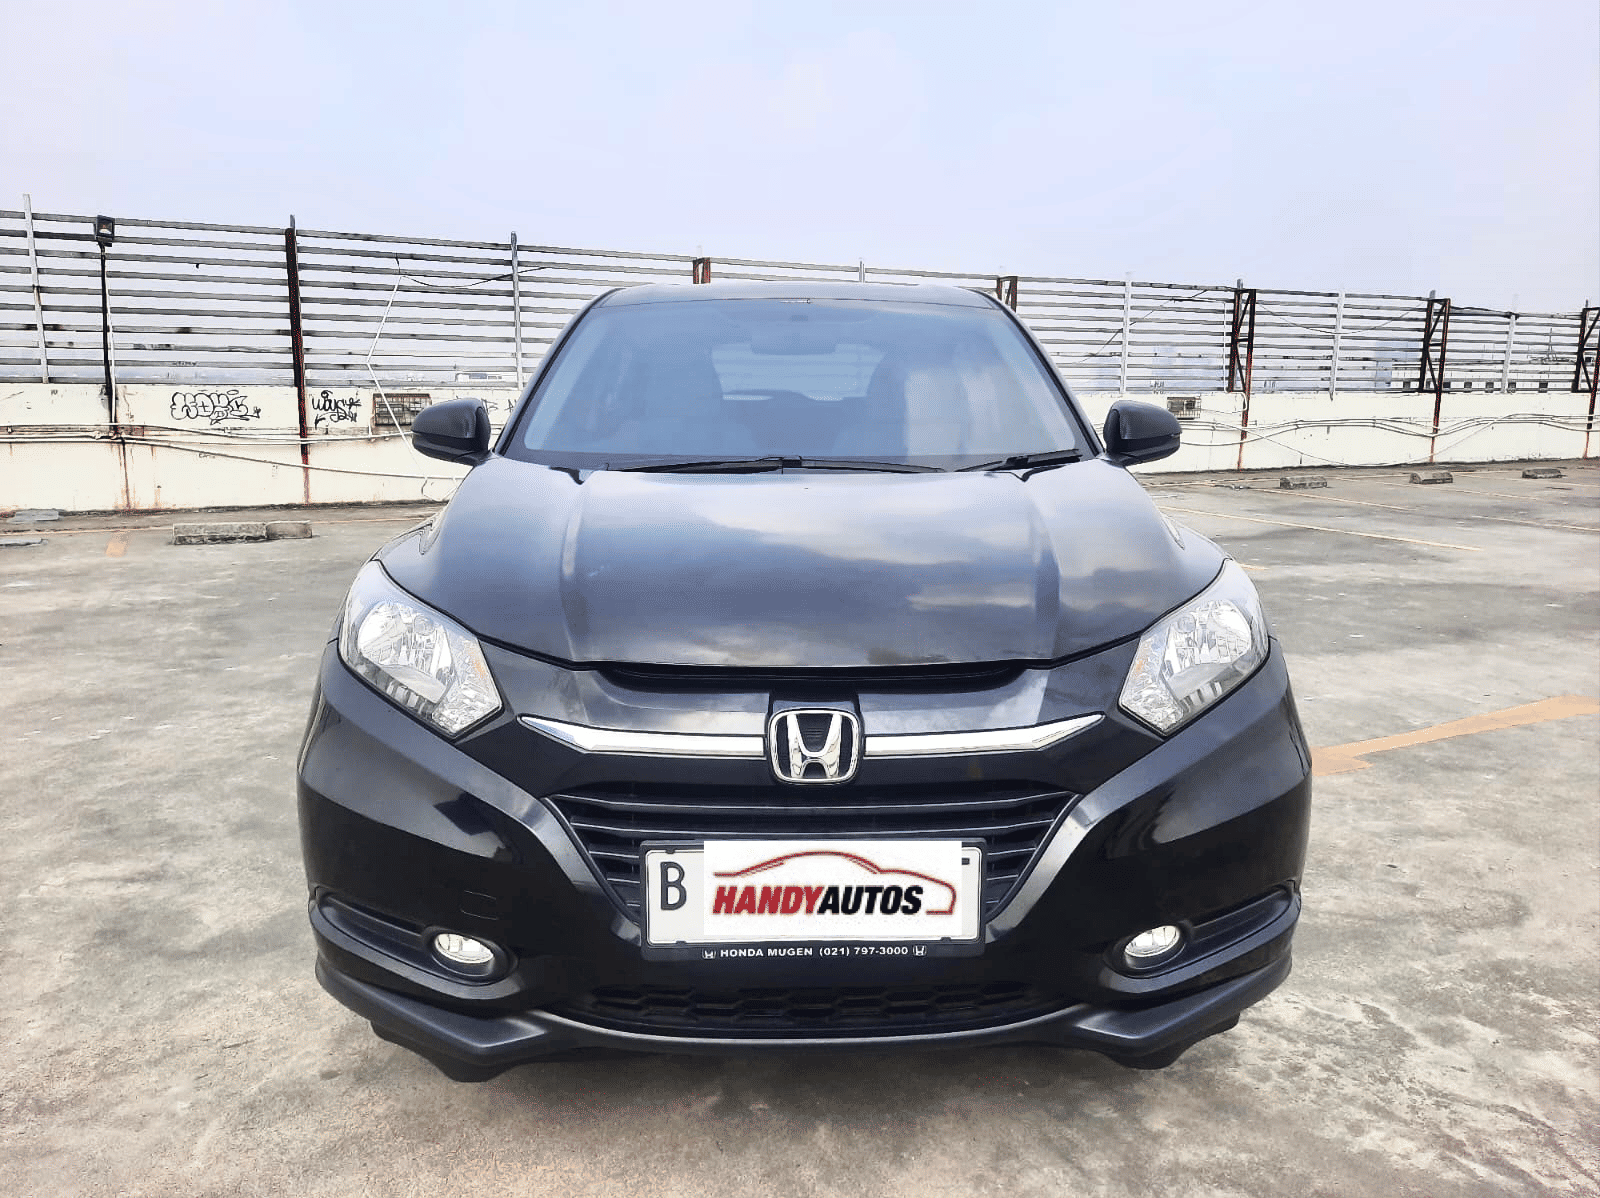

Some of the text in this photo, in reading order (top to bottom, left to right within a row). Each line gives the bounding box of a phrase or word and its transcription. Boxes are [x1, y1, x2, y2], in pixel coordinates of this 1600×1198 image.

[660, 861, 687, 911] B
[720, 948, 764, 958] HONDA
[767, 947, 813, 957] MUGEN
[819, 946, 850, 957] (021)
[854, 946, 909, 955] 797-3000
